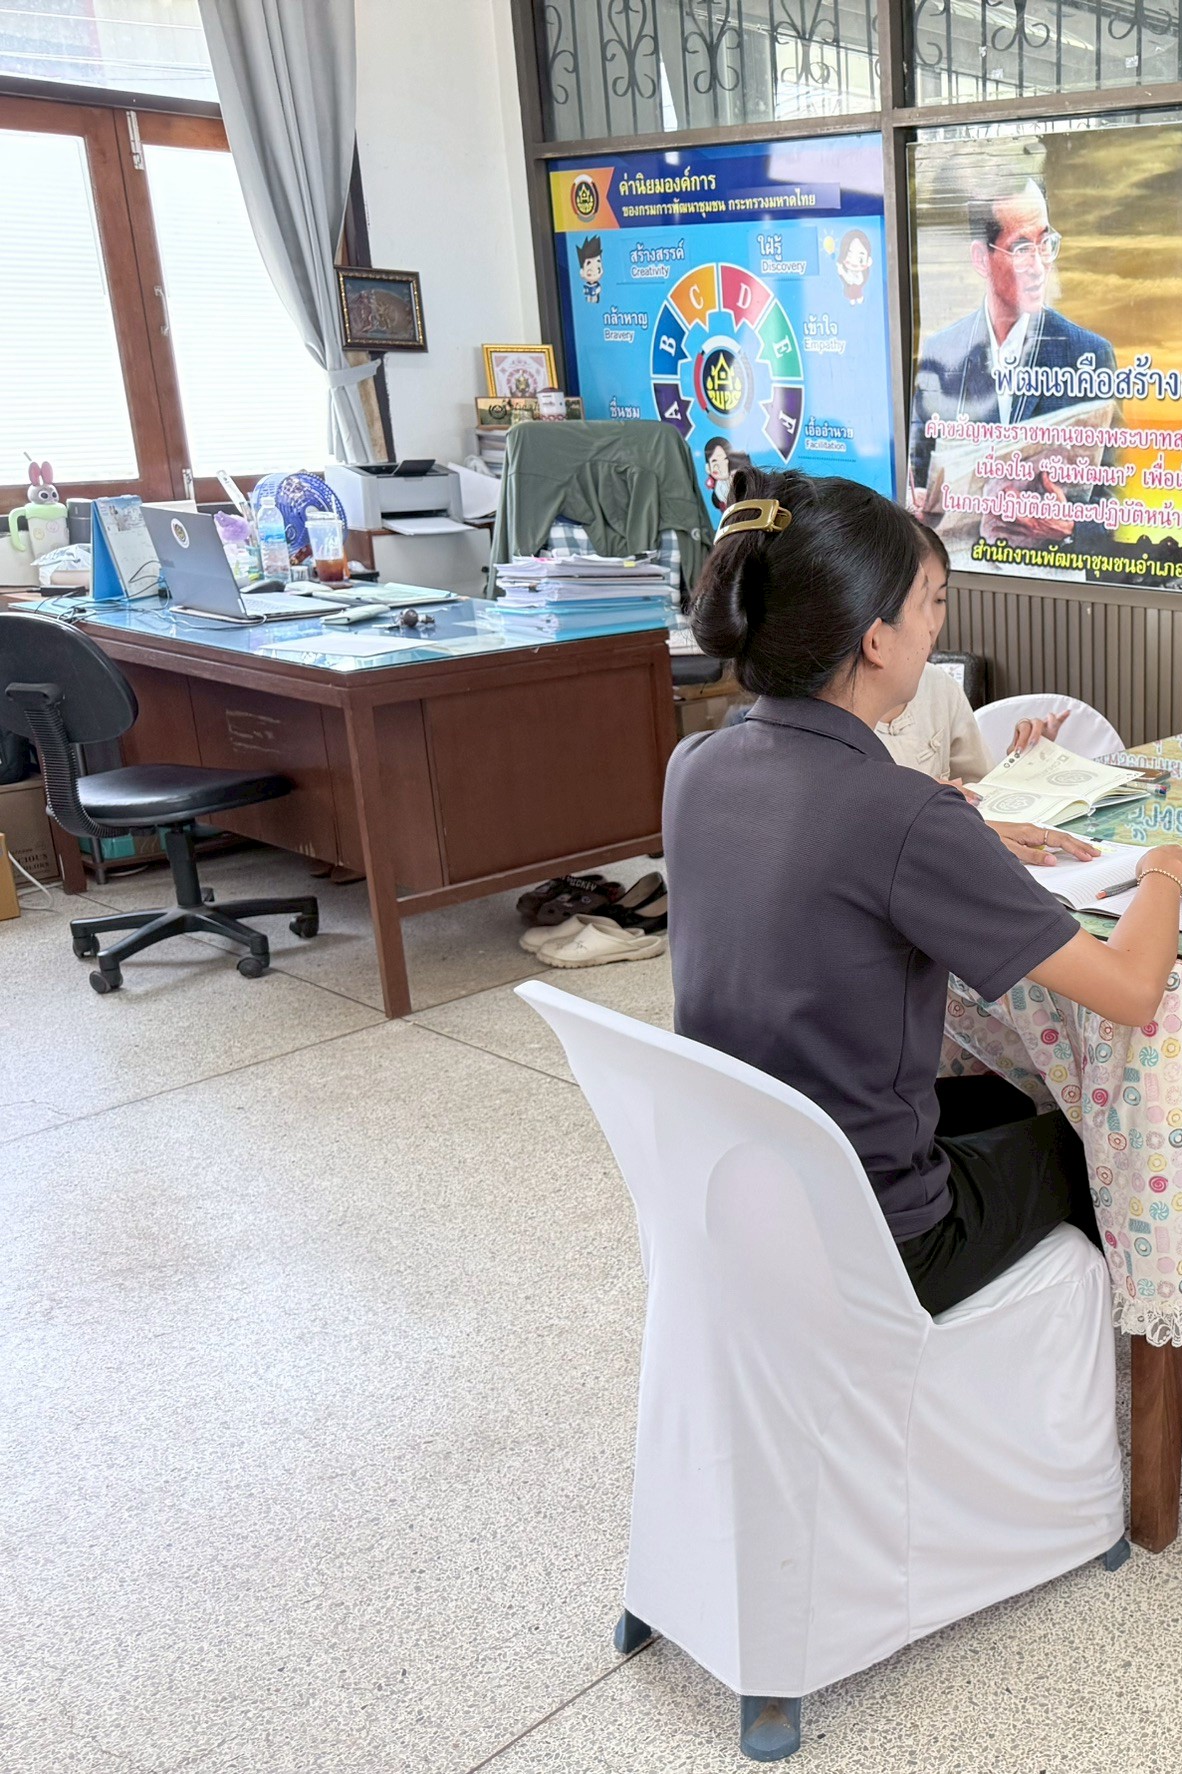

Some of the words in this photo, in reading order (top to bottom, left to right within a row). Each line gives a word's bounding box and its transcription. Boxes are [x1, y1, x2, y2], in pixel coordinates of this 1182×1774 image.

[619, 166, 716, 196] ค่านิยมองค์การ
[630, 238, 685, 263] สร้างสรรค์
[631, 265, 670, 279] Creativity
[762, 260, 806, 273] Discovery
[689, 284, 704, 309] C
[736, 283, 751, 309] D
[603, 306, 648, 329] กล้าหาญ
[804, 315, 838, 335] เข้าใจ
[604, 330, 634, 342] Bravery
[659, 335, 676, 356] B
[773, 335, 792, 358] E
[804, 339, 845, 354] Empathy
[664, 401, 681, 420] A
[805, 439, 846, 451] Facilitation
[976, 447, 1035, 480] เนื่องใน
